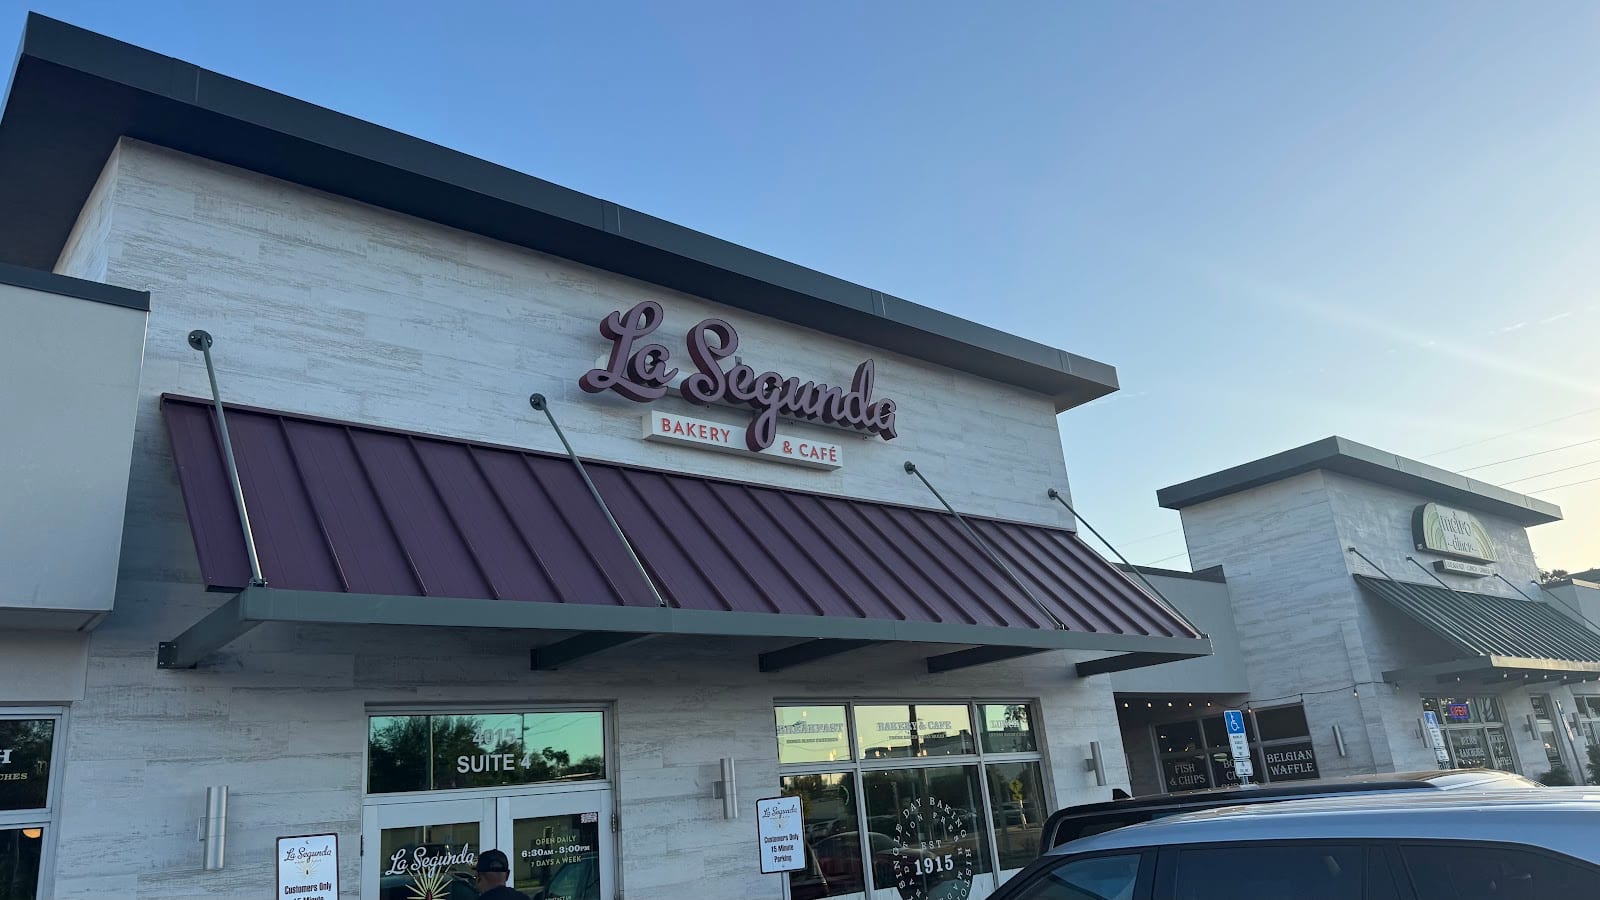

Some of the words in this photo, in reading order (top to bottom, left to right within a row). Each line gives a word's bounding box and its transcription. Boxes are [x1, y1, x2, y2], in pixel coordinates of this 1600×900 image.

[579, 300, 679, 403] La
[680, 318, 898, 451] Segunda
[660, 417, 731, 443] BAKERY
[782, 440, 793, 454] &
[799, 444, 838, 462] CAFÉ
[878, 721, 917, 731] BAKERY
[919, 721, 927, 730] &
[472, 727, 517, 746] 4015
[457, 753, 515, 774] SUITE
[520, 752, 532, 769] 4
[1266, 750, 1313, 763] BELGIAN
[1174, 763, 1196, 774] FISH
[1270, 763, 1314, 776] WAFFLE
[1169, 778, 1177, 786] &
[1178, 774, 1206, 785] CHIPS
[902, 798, 922, 819] DAY
[929, 796, 967, 838] BAKING
[535, 837, 556, 846] OPEN
[557, 835, 577, 844] DAILY
[921, 840, 942, 850] EST
[283, 847, 296, 862] La
[297, 845, 332, 863] Segunda
[778, 844, 794, 852] Minute
[385, 848, 408, 876] La
[411, 842, 475, 879] Segunda
[536, 858, 554, 867] DAYS
[562, 855, 582, 864] WEEK
[914, 854, 954, 876] 1915
[284, 884, 318, 895] Customers
[319, 881, 332, 891] Only
